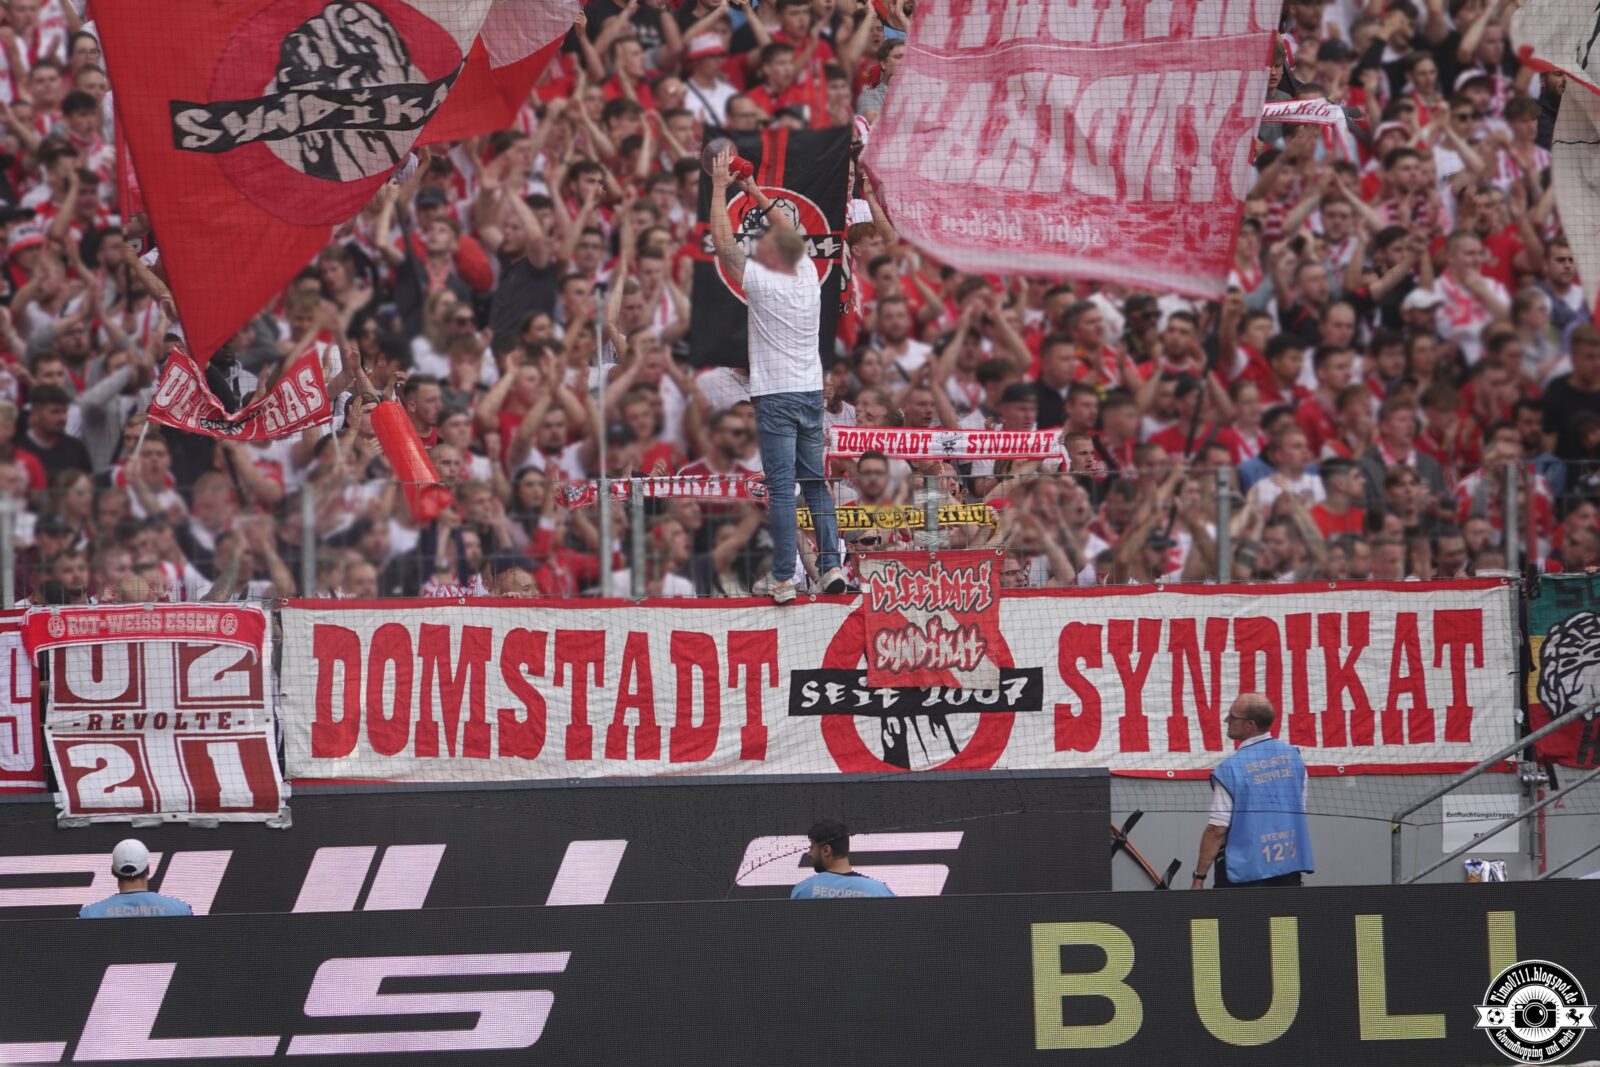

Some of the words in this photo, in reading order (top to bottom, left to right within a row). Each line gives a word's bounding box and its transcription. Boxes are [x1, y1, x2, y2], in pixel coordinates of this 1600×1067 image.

[1263, 105, 1290, 117] lub
[1293, 102, 1330, 117] Köln
[837, 431, 931, 455] DOMSTADT
[967, 433, 1054, 454] SYNDIKAT
[67, 613, 162, 635] ROT-WEISS
[165, 612, 218, 632] ESSEN
[311, 622, 780, 763] DOMSTADT
[1054, 608, 1484, 754] SYNDIKAT
[1446, 811, 1516, 819] Entfluchtungstreppe
[813, 885, 871, 898] SECURITY
[106, 904, 166, 917] SECURITY
